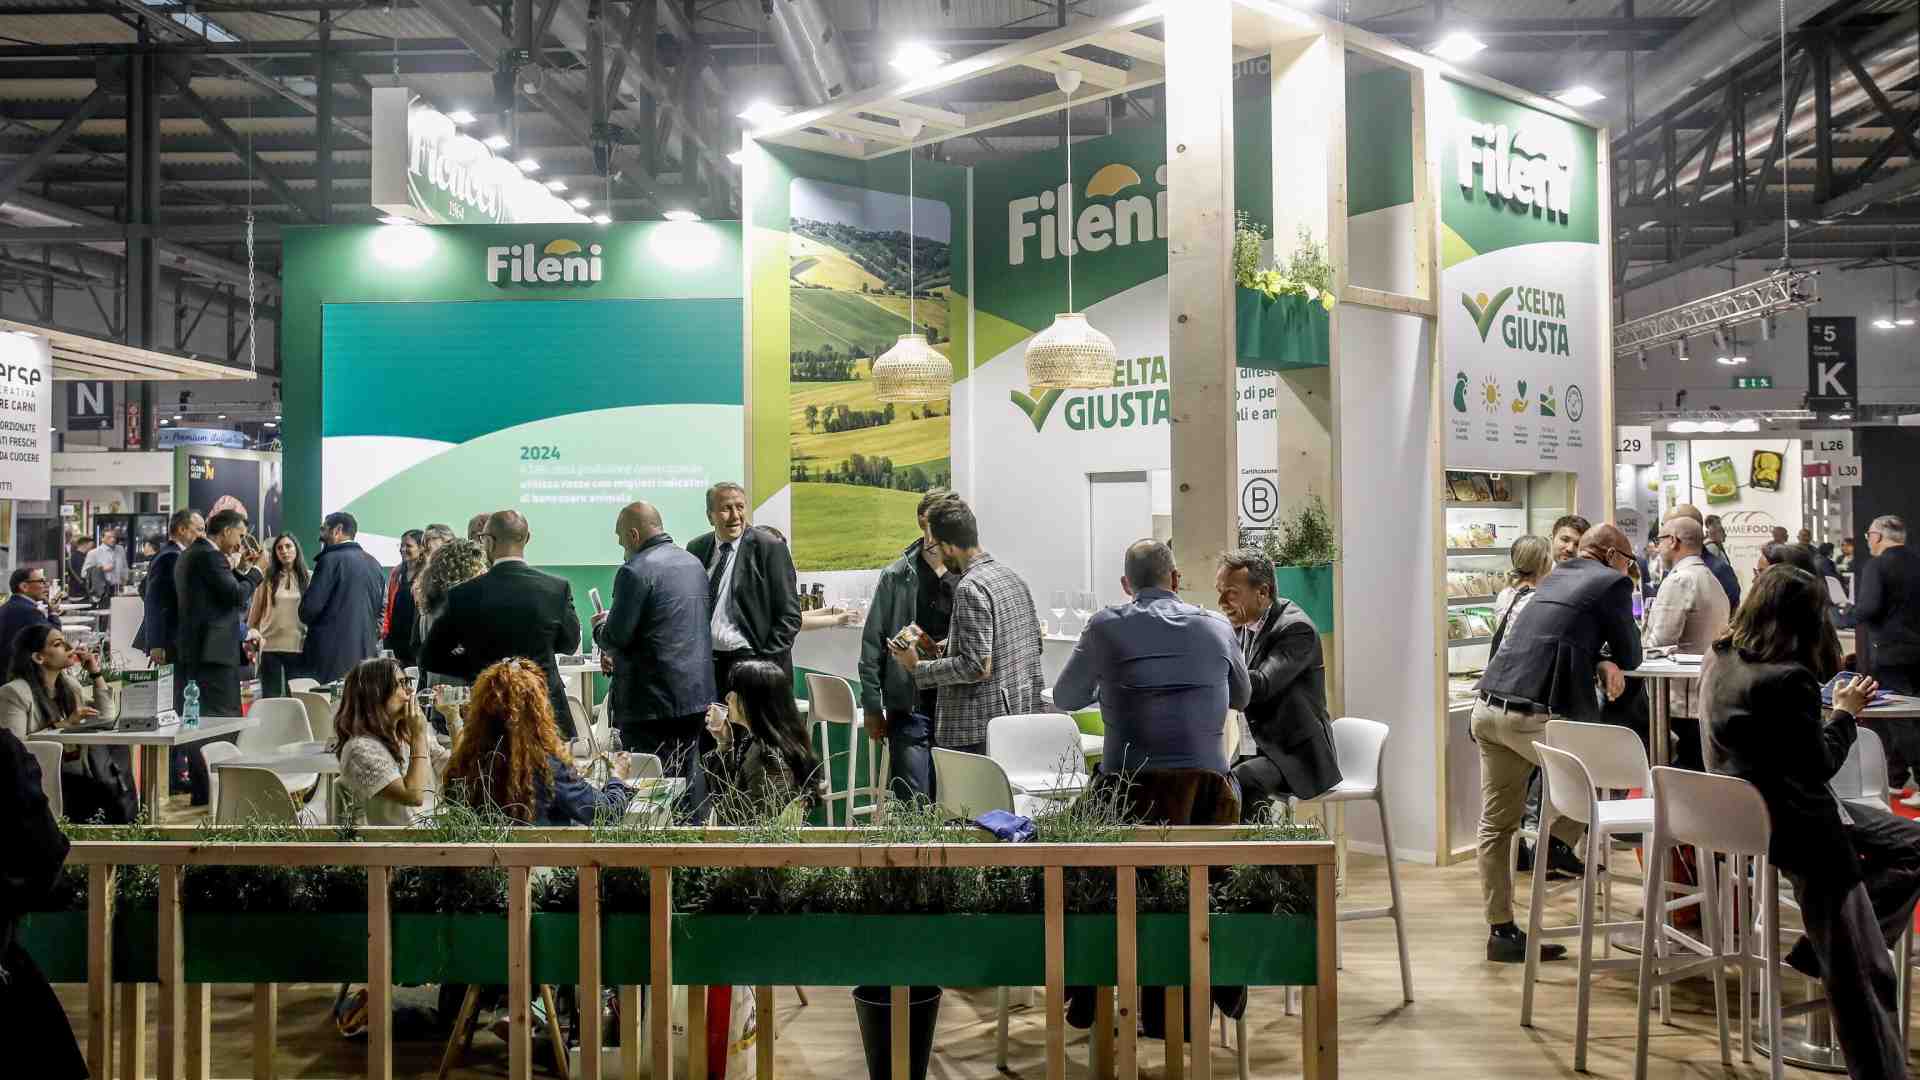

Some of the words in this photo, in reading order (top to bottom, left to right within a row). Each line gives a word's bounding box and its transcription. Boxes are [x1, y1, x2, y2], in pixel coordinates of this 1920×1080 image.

[1008, 164, 1168, 265] Fileni
[487, 244, 602, 283] Fileni
[1517, 286, 1566, 319] SCELTA
[1502, 314, 1569, 357] GIUSTA
[1823, 325, 1837, 342] 5
[1113, 356, 1168, 388] ELTA
[1818, 362, 1848, 395] K
[77, 382, 104, 415] N
[1244, 385, 1255, 400] di
[11, 400, 36, 413] CARNI
[1064, 388, 1170, 431] GIUSTA
[1251, 409, 1259, 420] e
[9, 437, 37, 448] FRESCHI
[520, 446, 560, 460] 2024
[1821, 440, 1844, 451] L26
[9, 451, 40, 463] CUOCERE
[1252, 487, 1270, 513] B
